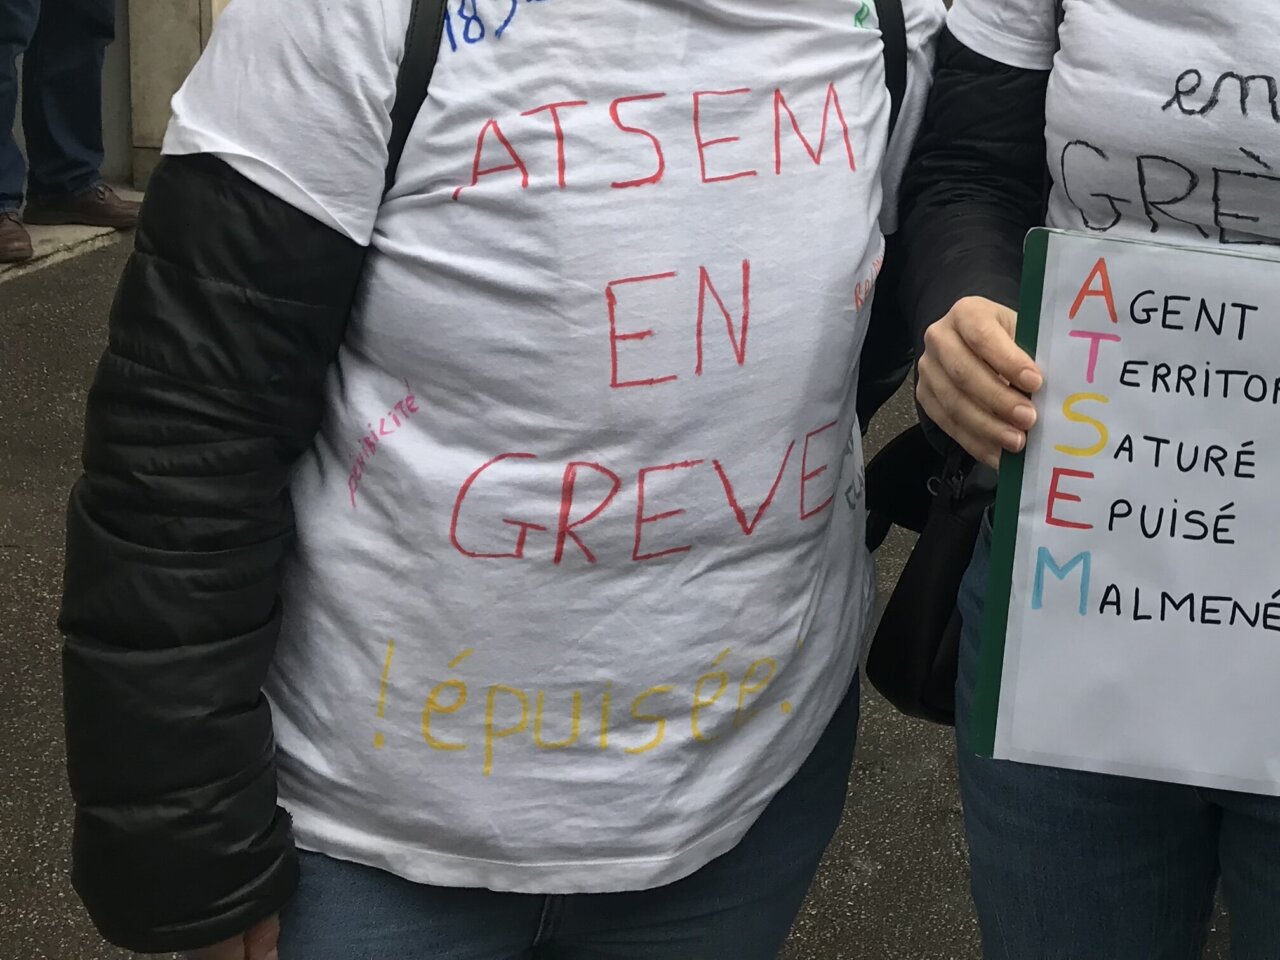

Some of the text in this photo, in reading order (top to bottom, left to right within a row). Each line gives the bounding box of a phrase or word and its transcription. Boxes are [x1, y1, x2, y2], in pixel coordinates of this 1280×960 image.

[452, 81, 856, 200] ATSEM
[605, 259, 749, 388] EN
[1068, 257, 1258, 341] AGENT
[450, 421, 838, 564] GREVE
[1054, 392, 1256, 479] SATURÉ
